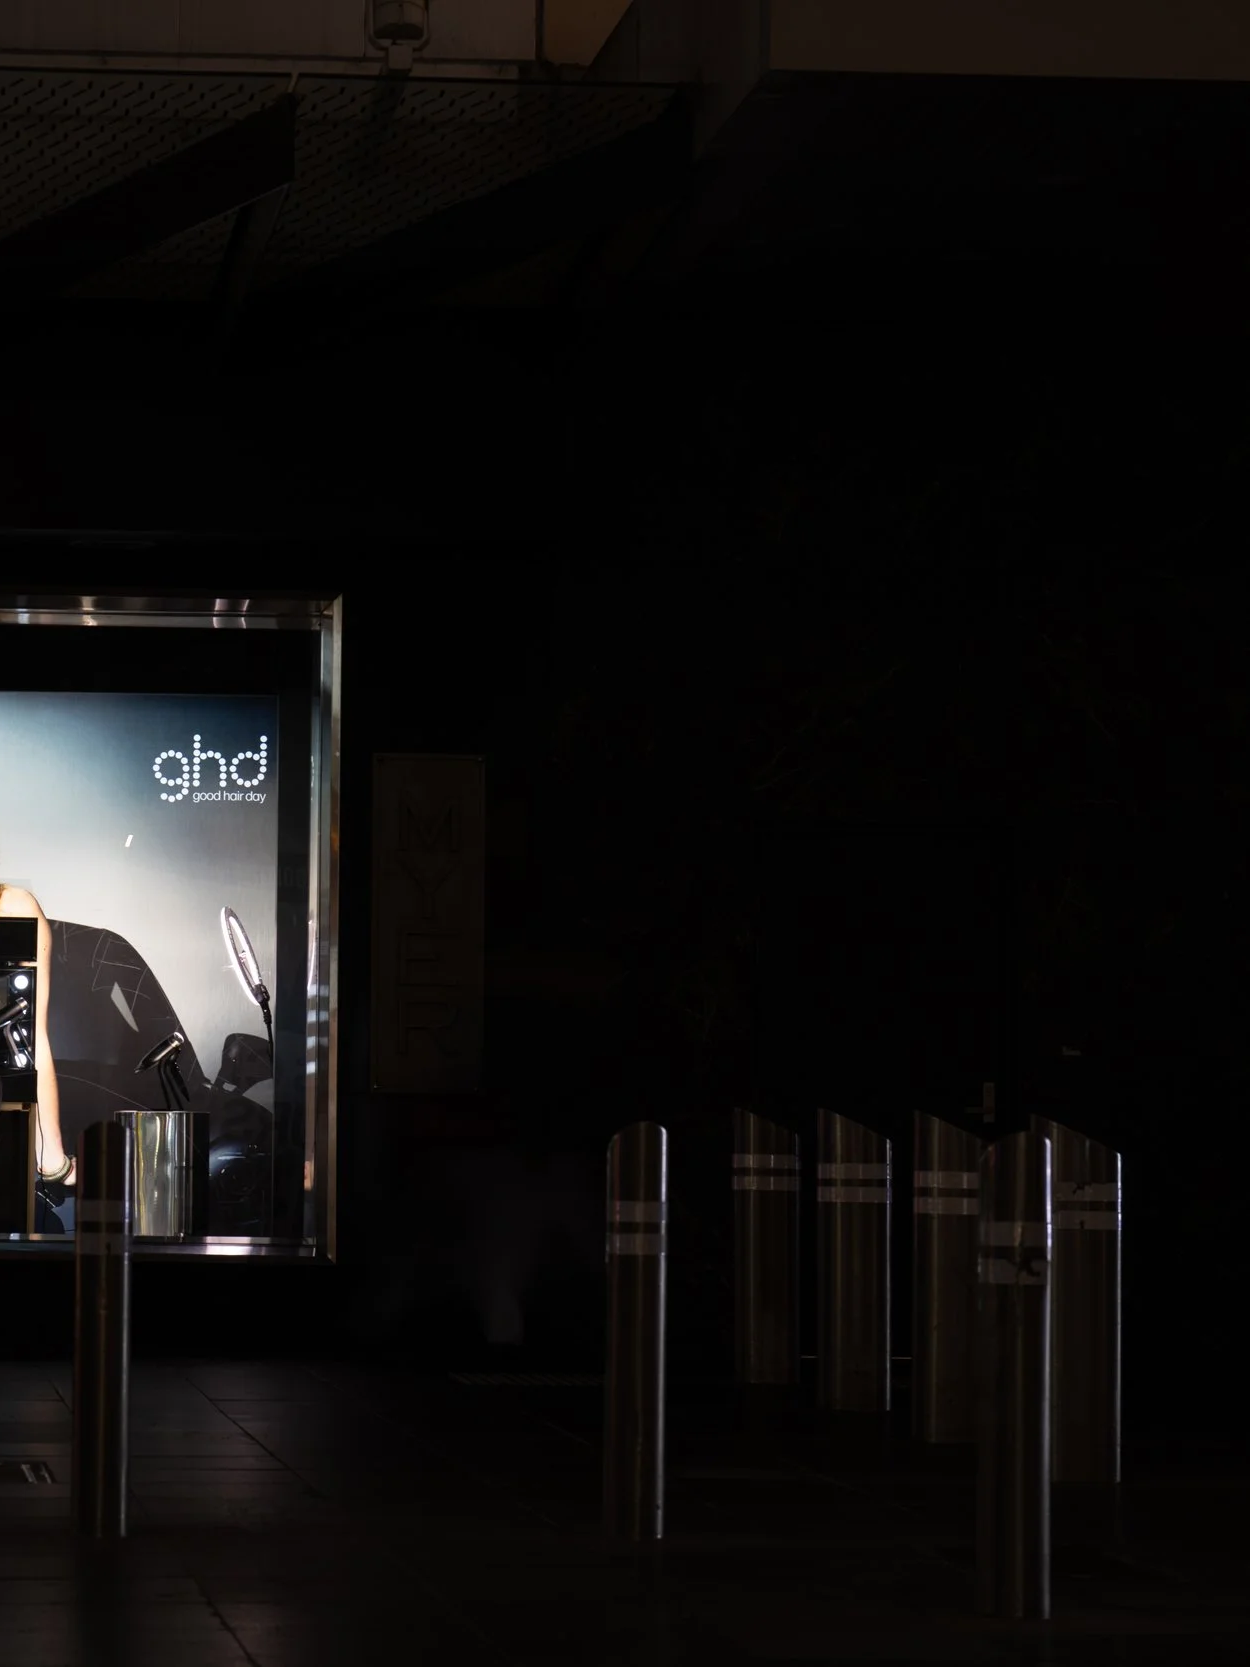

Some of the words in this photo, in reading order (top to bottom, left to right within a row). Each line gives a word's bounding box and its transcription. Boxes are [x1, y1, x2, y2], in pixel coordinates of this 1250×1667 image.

[153, 734, 268, 802] ghd
[193, 791, 221, 802] good
[223, 791, 244, 801] hair
[245, 791, 266, 803] day
[395, 797, 461, 1056] MYER
